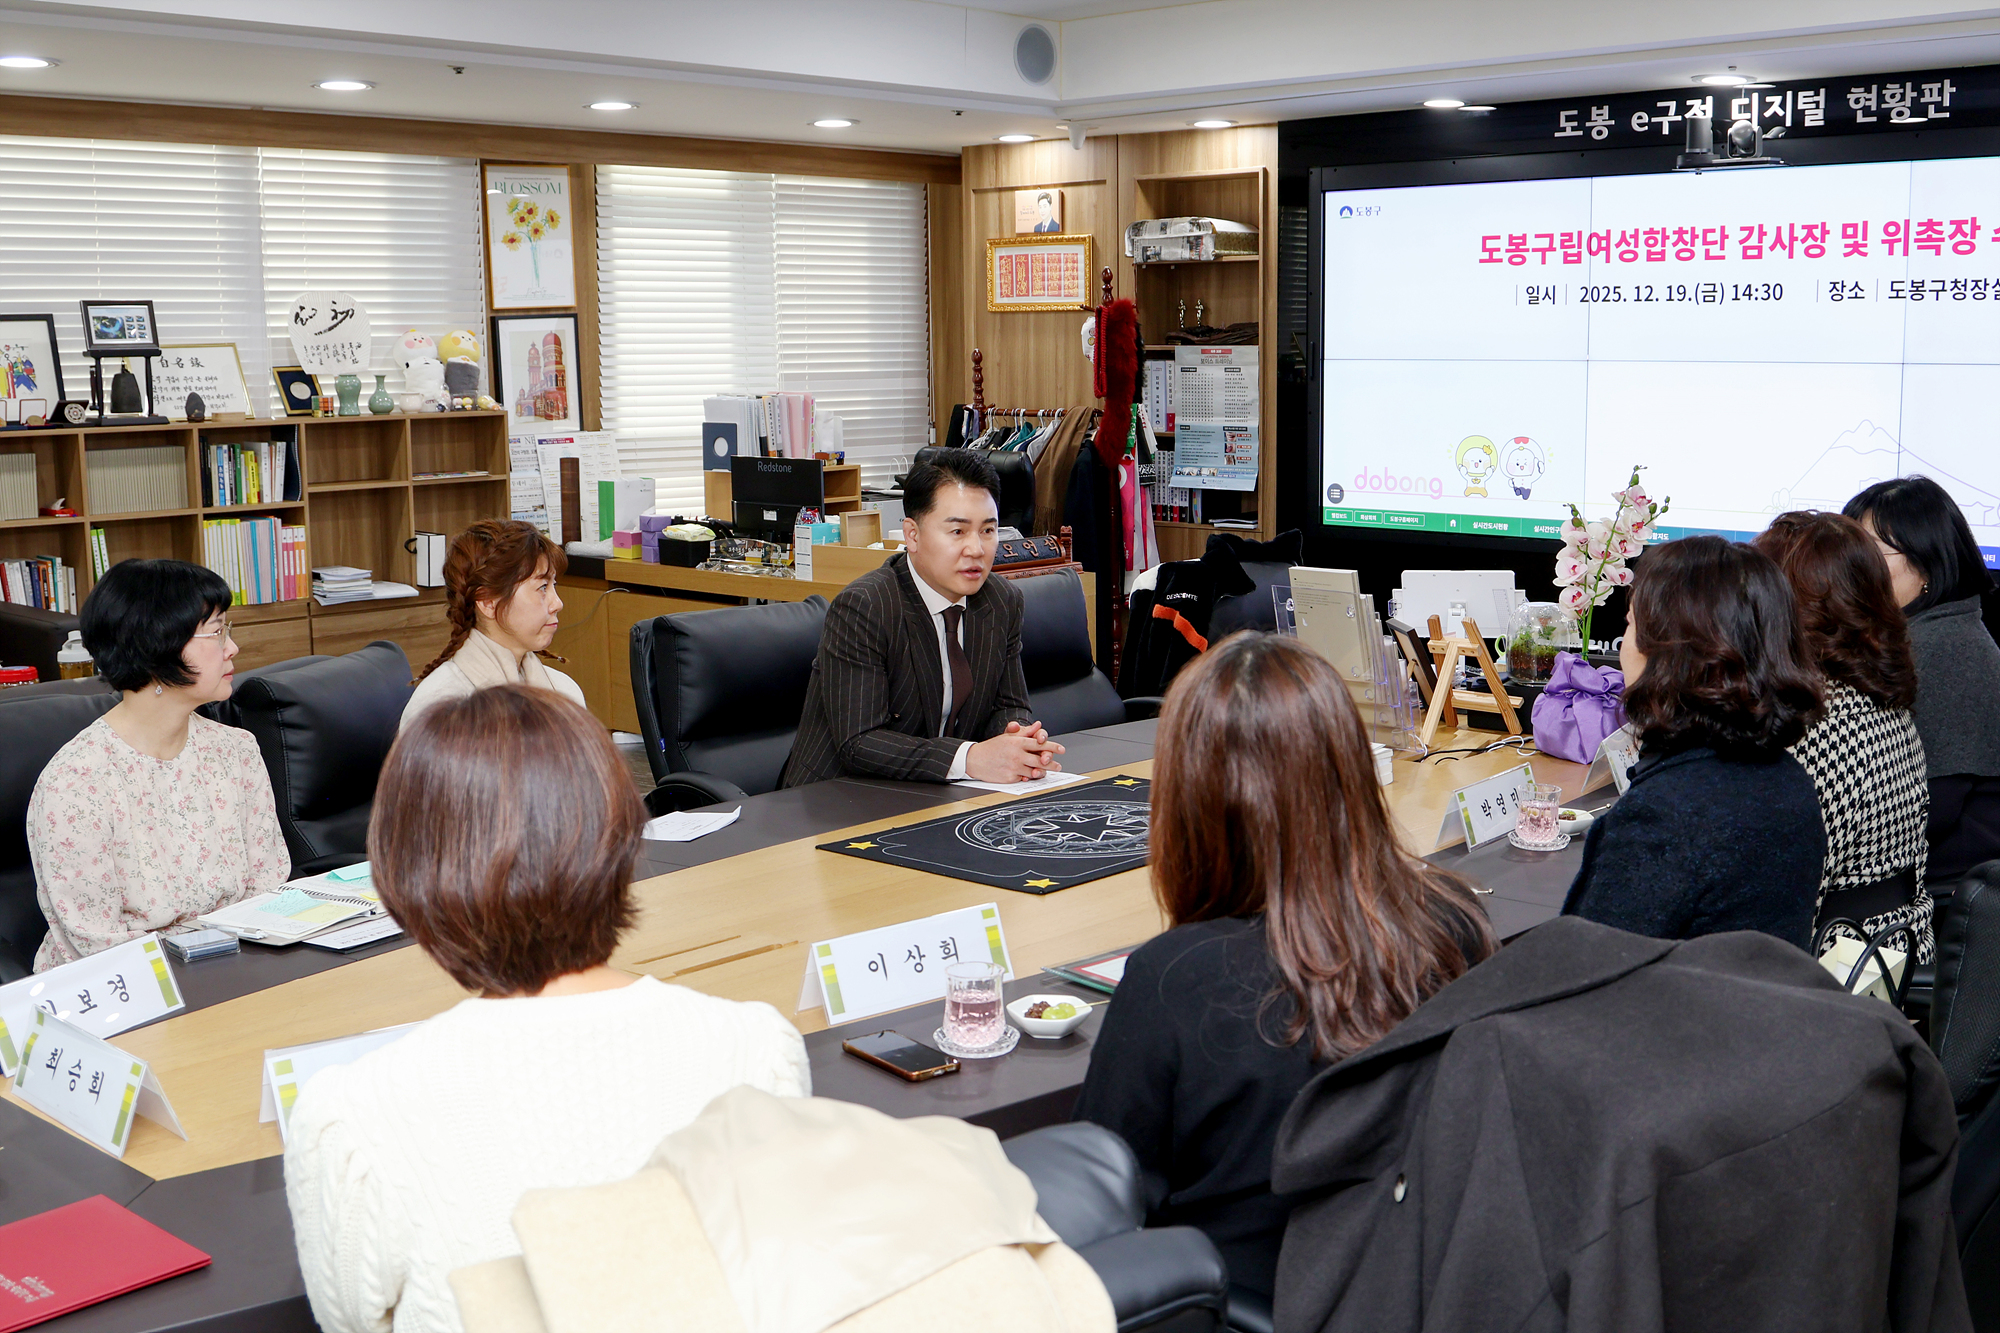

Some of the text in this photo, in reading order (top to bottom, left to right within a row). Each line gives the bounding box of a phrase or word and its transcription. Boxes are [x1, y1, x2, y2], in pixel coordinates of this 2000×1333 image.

[1554, 105, 1615, 140] 도봉
[1731, 87, 1828, 129] 디지털
[1846, 79, 1957, 123] 현황판
[494, 181, 562, 195] BLOSSOM
[1356, 205, 1382, 217] 도봉구
[1478, 216, 1982, 266] 도봉구립여성합창단 감사장 및 위촉장
[1525, 282, 1784, 305] 일시 2025. 12. 19.(금) 14:30
[1828, 279, 1866, 302] 장소
[757, 461, 792, 473] Redstone
[1354, 465, 1443, 500] dobong
[1390, 515, 1419, 524] 도봉구홈페이지
[1472, 521, 1509, 531] 실시간도시현황
[867, 936, 960, 982] 이상희
[45, 1047, 105, 1106] 최승희
